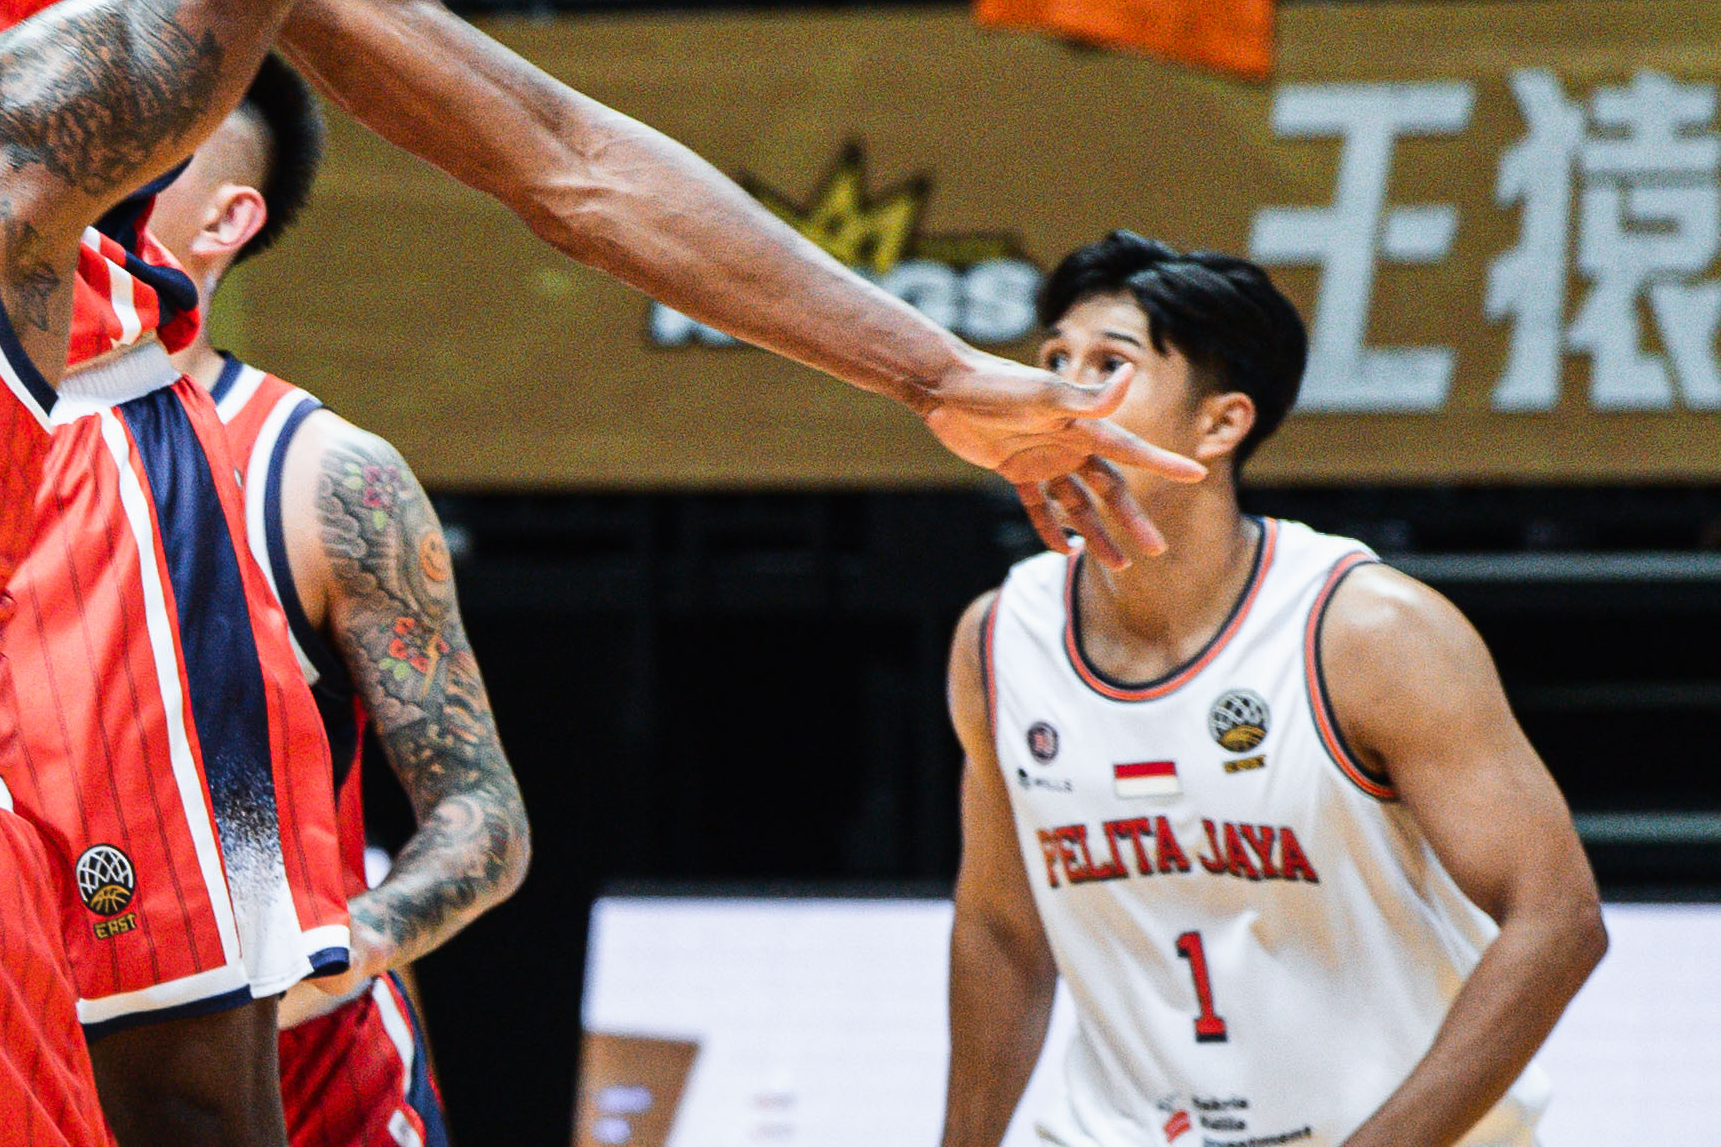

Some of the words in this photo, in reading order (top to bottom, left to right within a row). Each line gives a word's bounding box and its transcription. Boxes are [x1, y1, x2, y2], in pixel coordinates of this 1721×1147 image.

[1035, 816, 1192, 889] PELITA
[1198, 818, 1321, 884] JAYA
[95, 913, 137, 938] EAST
[1176, 931, 1228, 1043] 1
